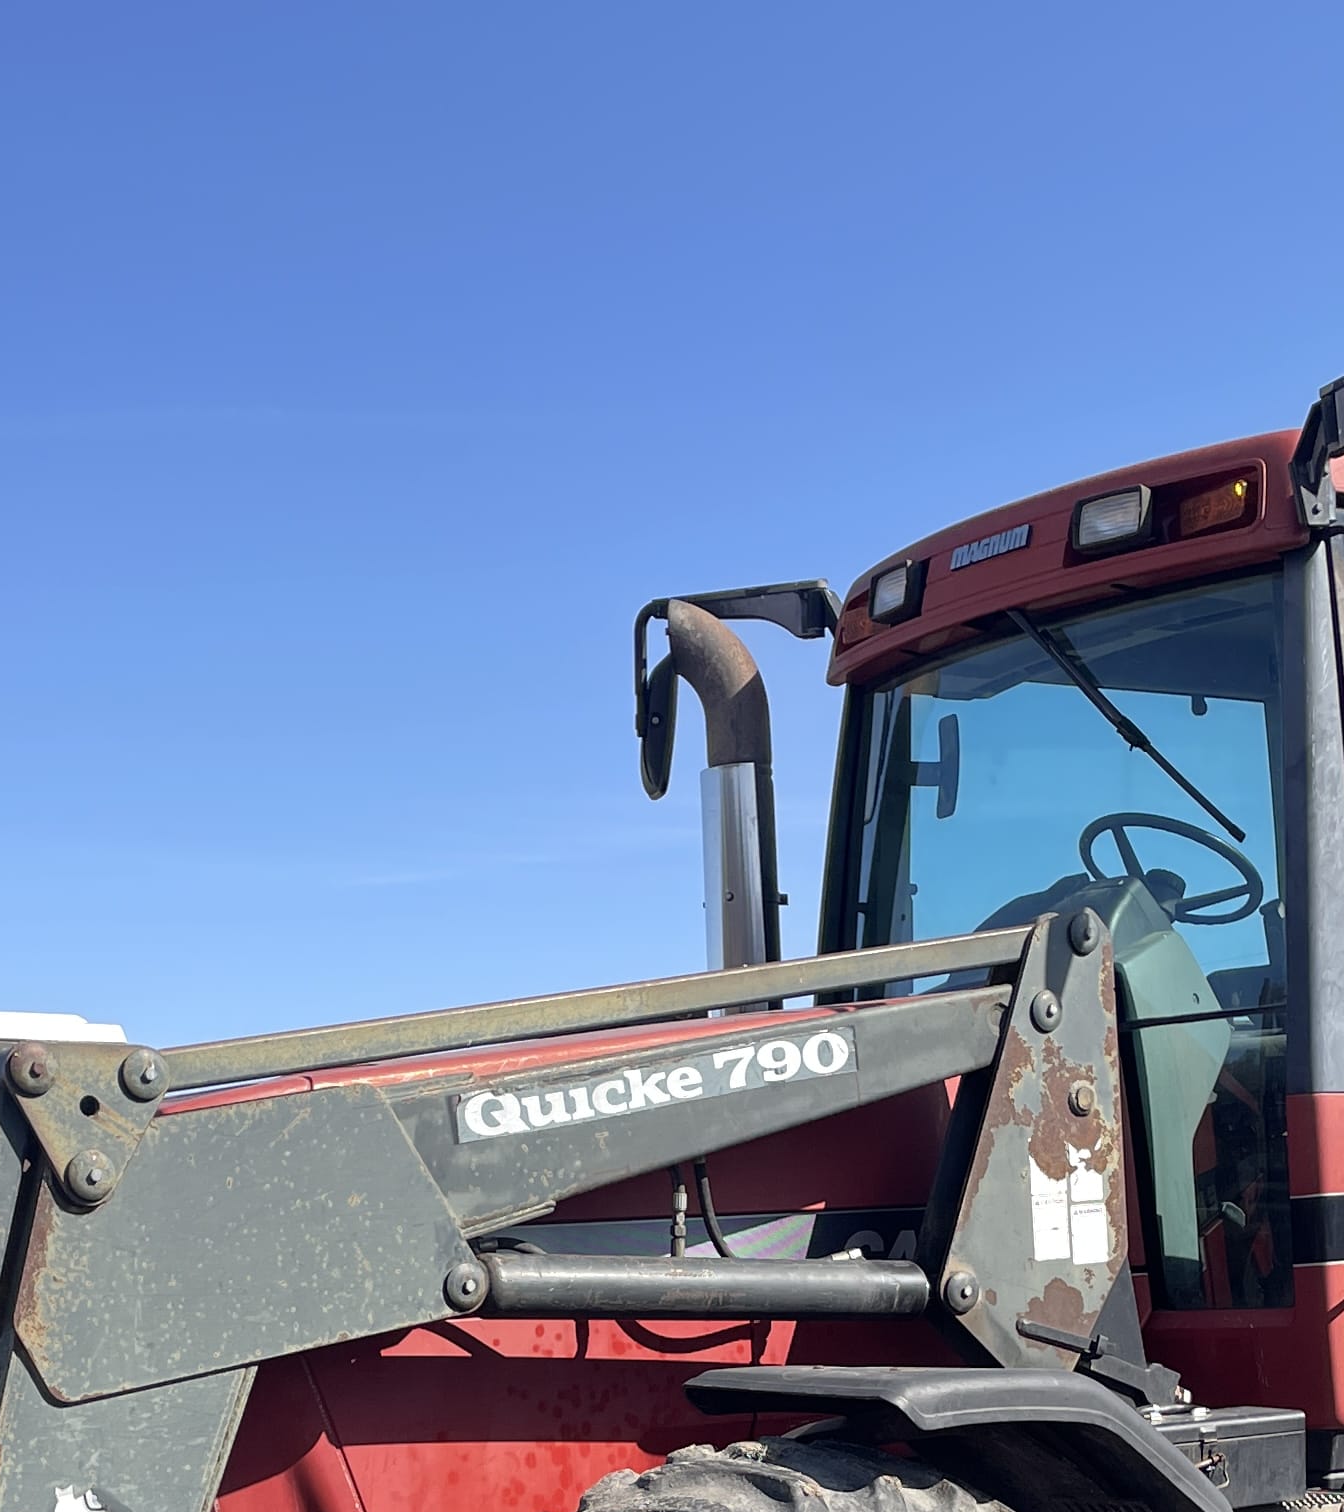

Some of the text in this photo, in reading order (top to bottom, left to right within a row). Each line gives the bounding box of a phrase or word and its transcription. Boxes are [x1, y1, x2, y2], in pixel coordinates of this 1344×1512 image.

[950, 523, 1030, 571] MAGNUM
[463, 1032, 850, 1137] Quicke 790
